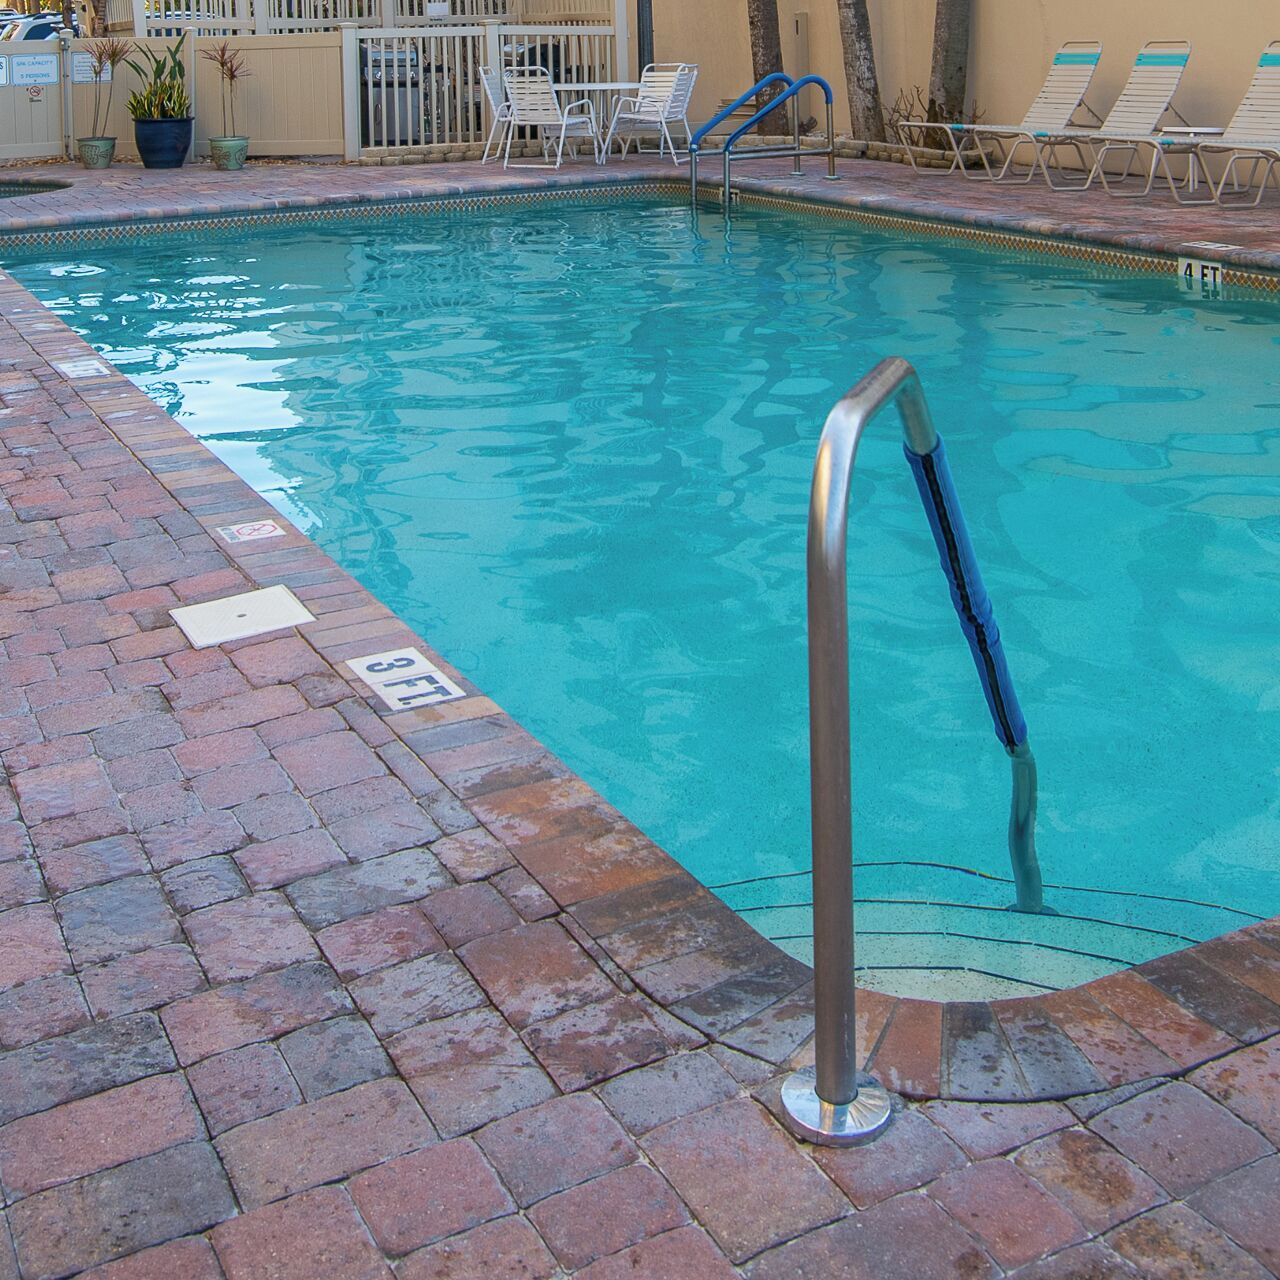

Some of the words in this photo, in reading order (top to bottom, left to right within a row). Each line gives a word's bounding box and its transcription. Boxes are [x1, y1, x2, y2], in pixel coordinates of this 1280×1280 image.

[1184, 263, 1193, 278] 4
[1201, 264, 1219, 282] FT
[365, 657, 416, 673] 3
